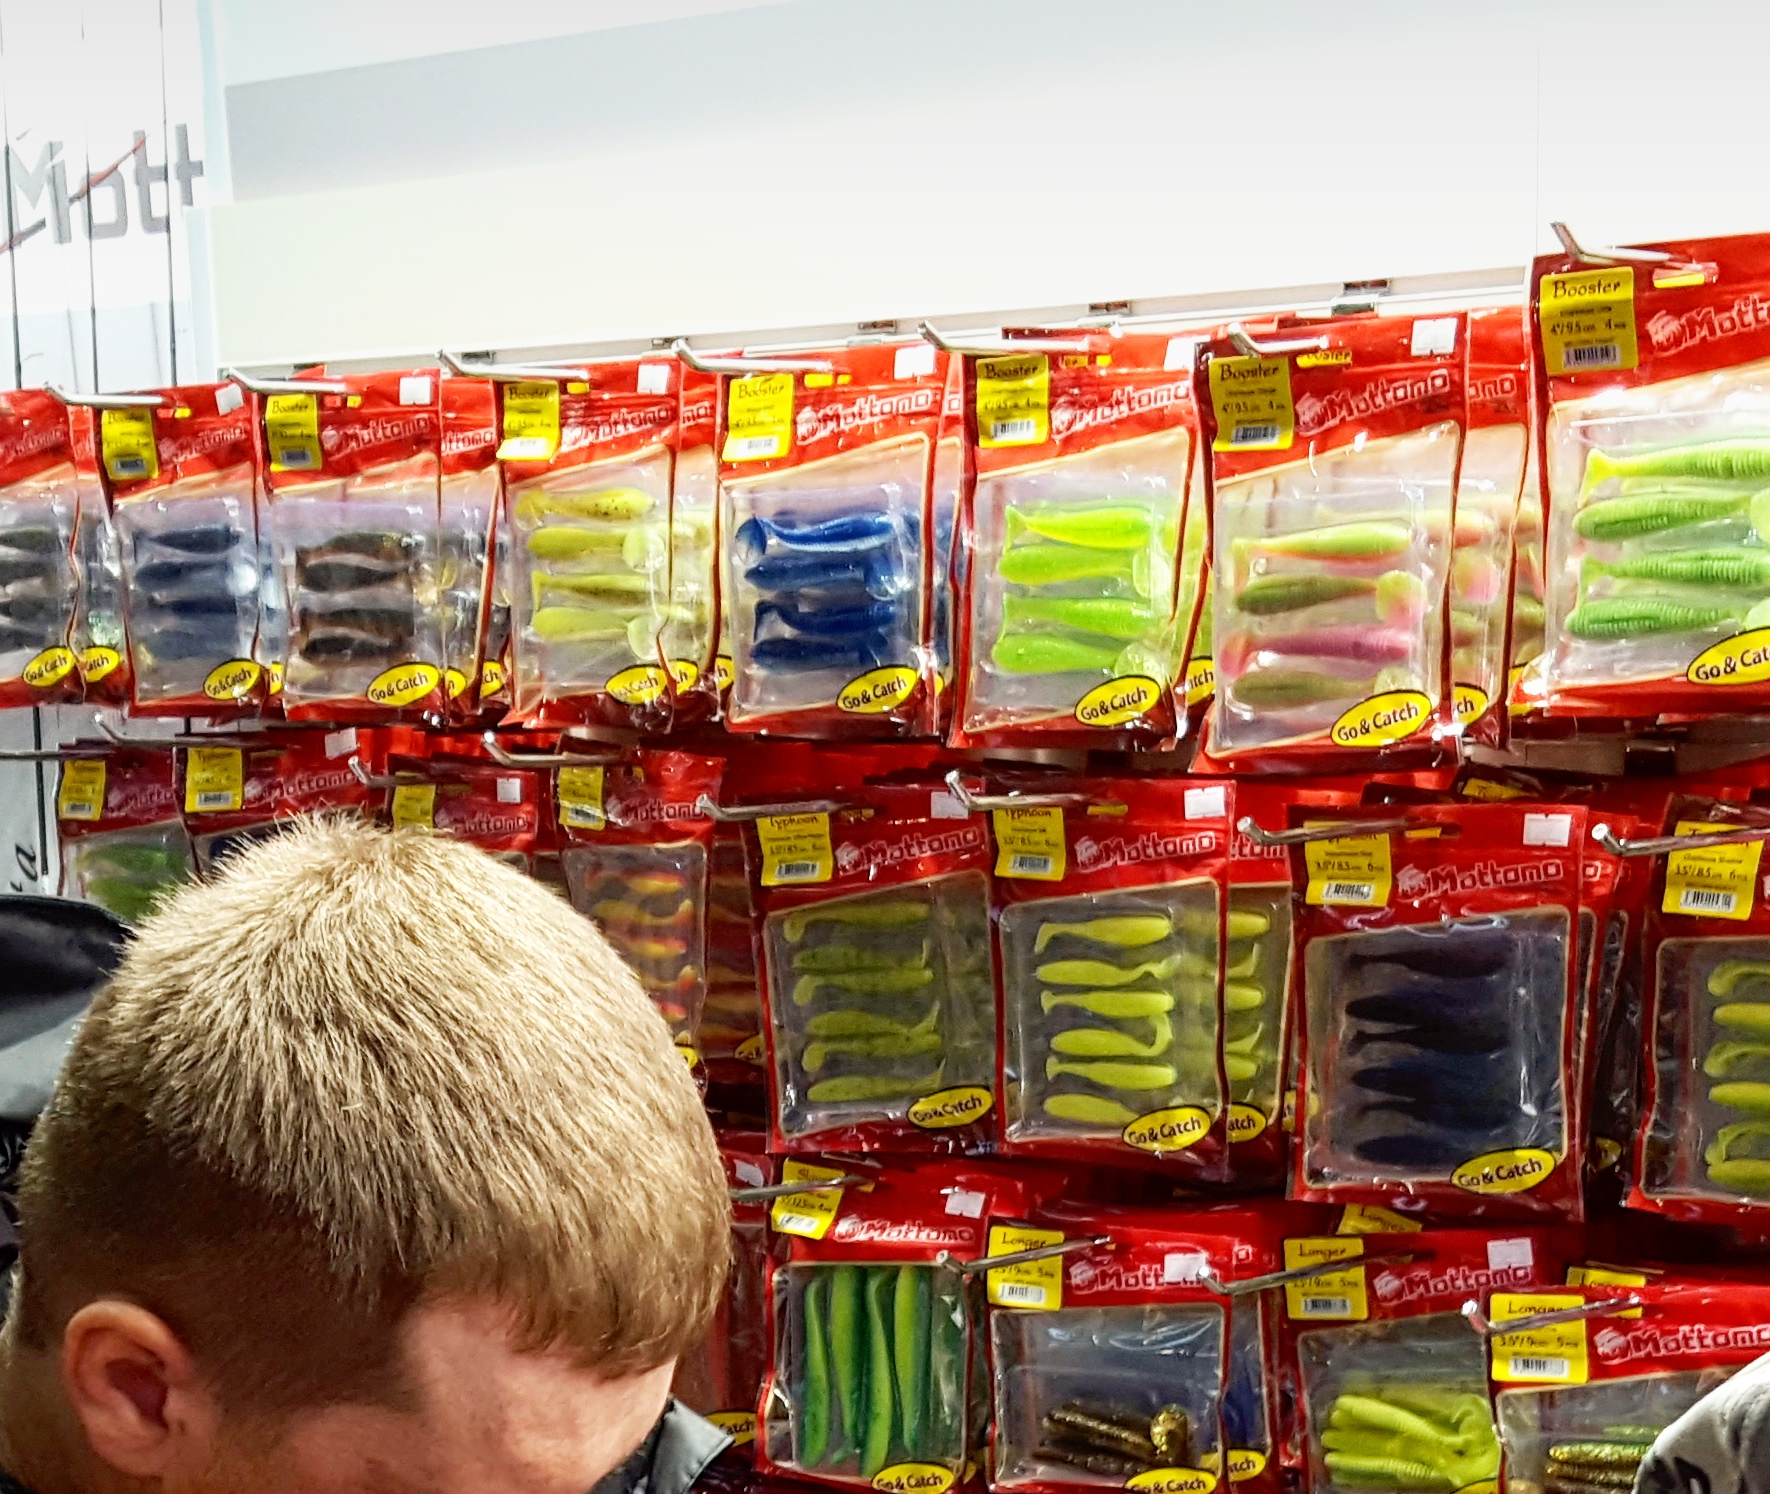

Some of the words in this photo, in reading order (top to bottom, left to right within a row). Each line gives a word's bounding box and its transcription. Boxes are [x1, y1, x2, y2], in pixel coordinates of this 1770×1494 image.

[1551, 278, 1622, 300] Booster
[985, 363, 1038, 380] Booster
[737, 383, 784, 399] Booster
[1694, 663, 1722, 682] Go
[1723, 656, 1737, 674] &
[843, 695, 861, 710] Go
[872, 674, 907, 698] Catch
[1081, 706, 1098, 720] Go
[1109, 687, 1148, 710] Catch
[1337, 725, 1358, 741] Go
[1372, 701, 1419, 728] Catch
[1160, 1117, 1202, 1139] Catch
[1496, 1158, 1543, 1181] Catch
[1165, 1476, 1206, 1491] Catch
